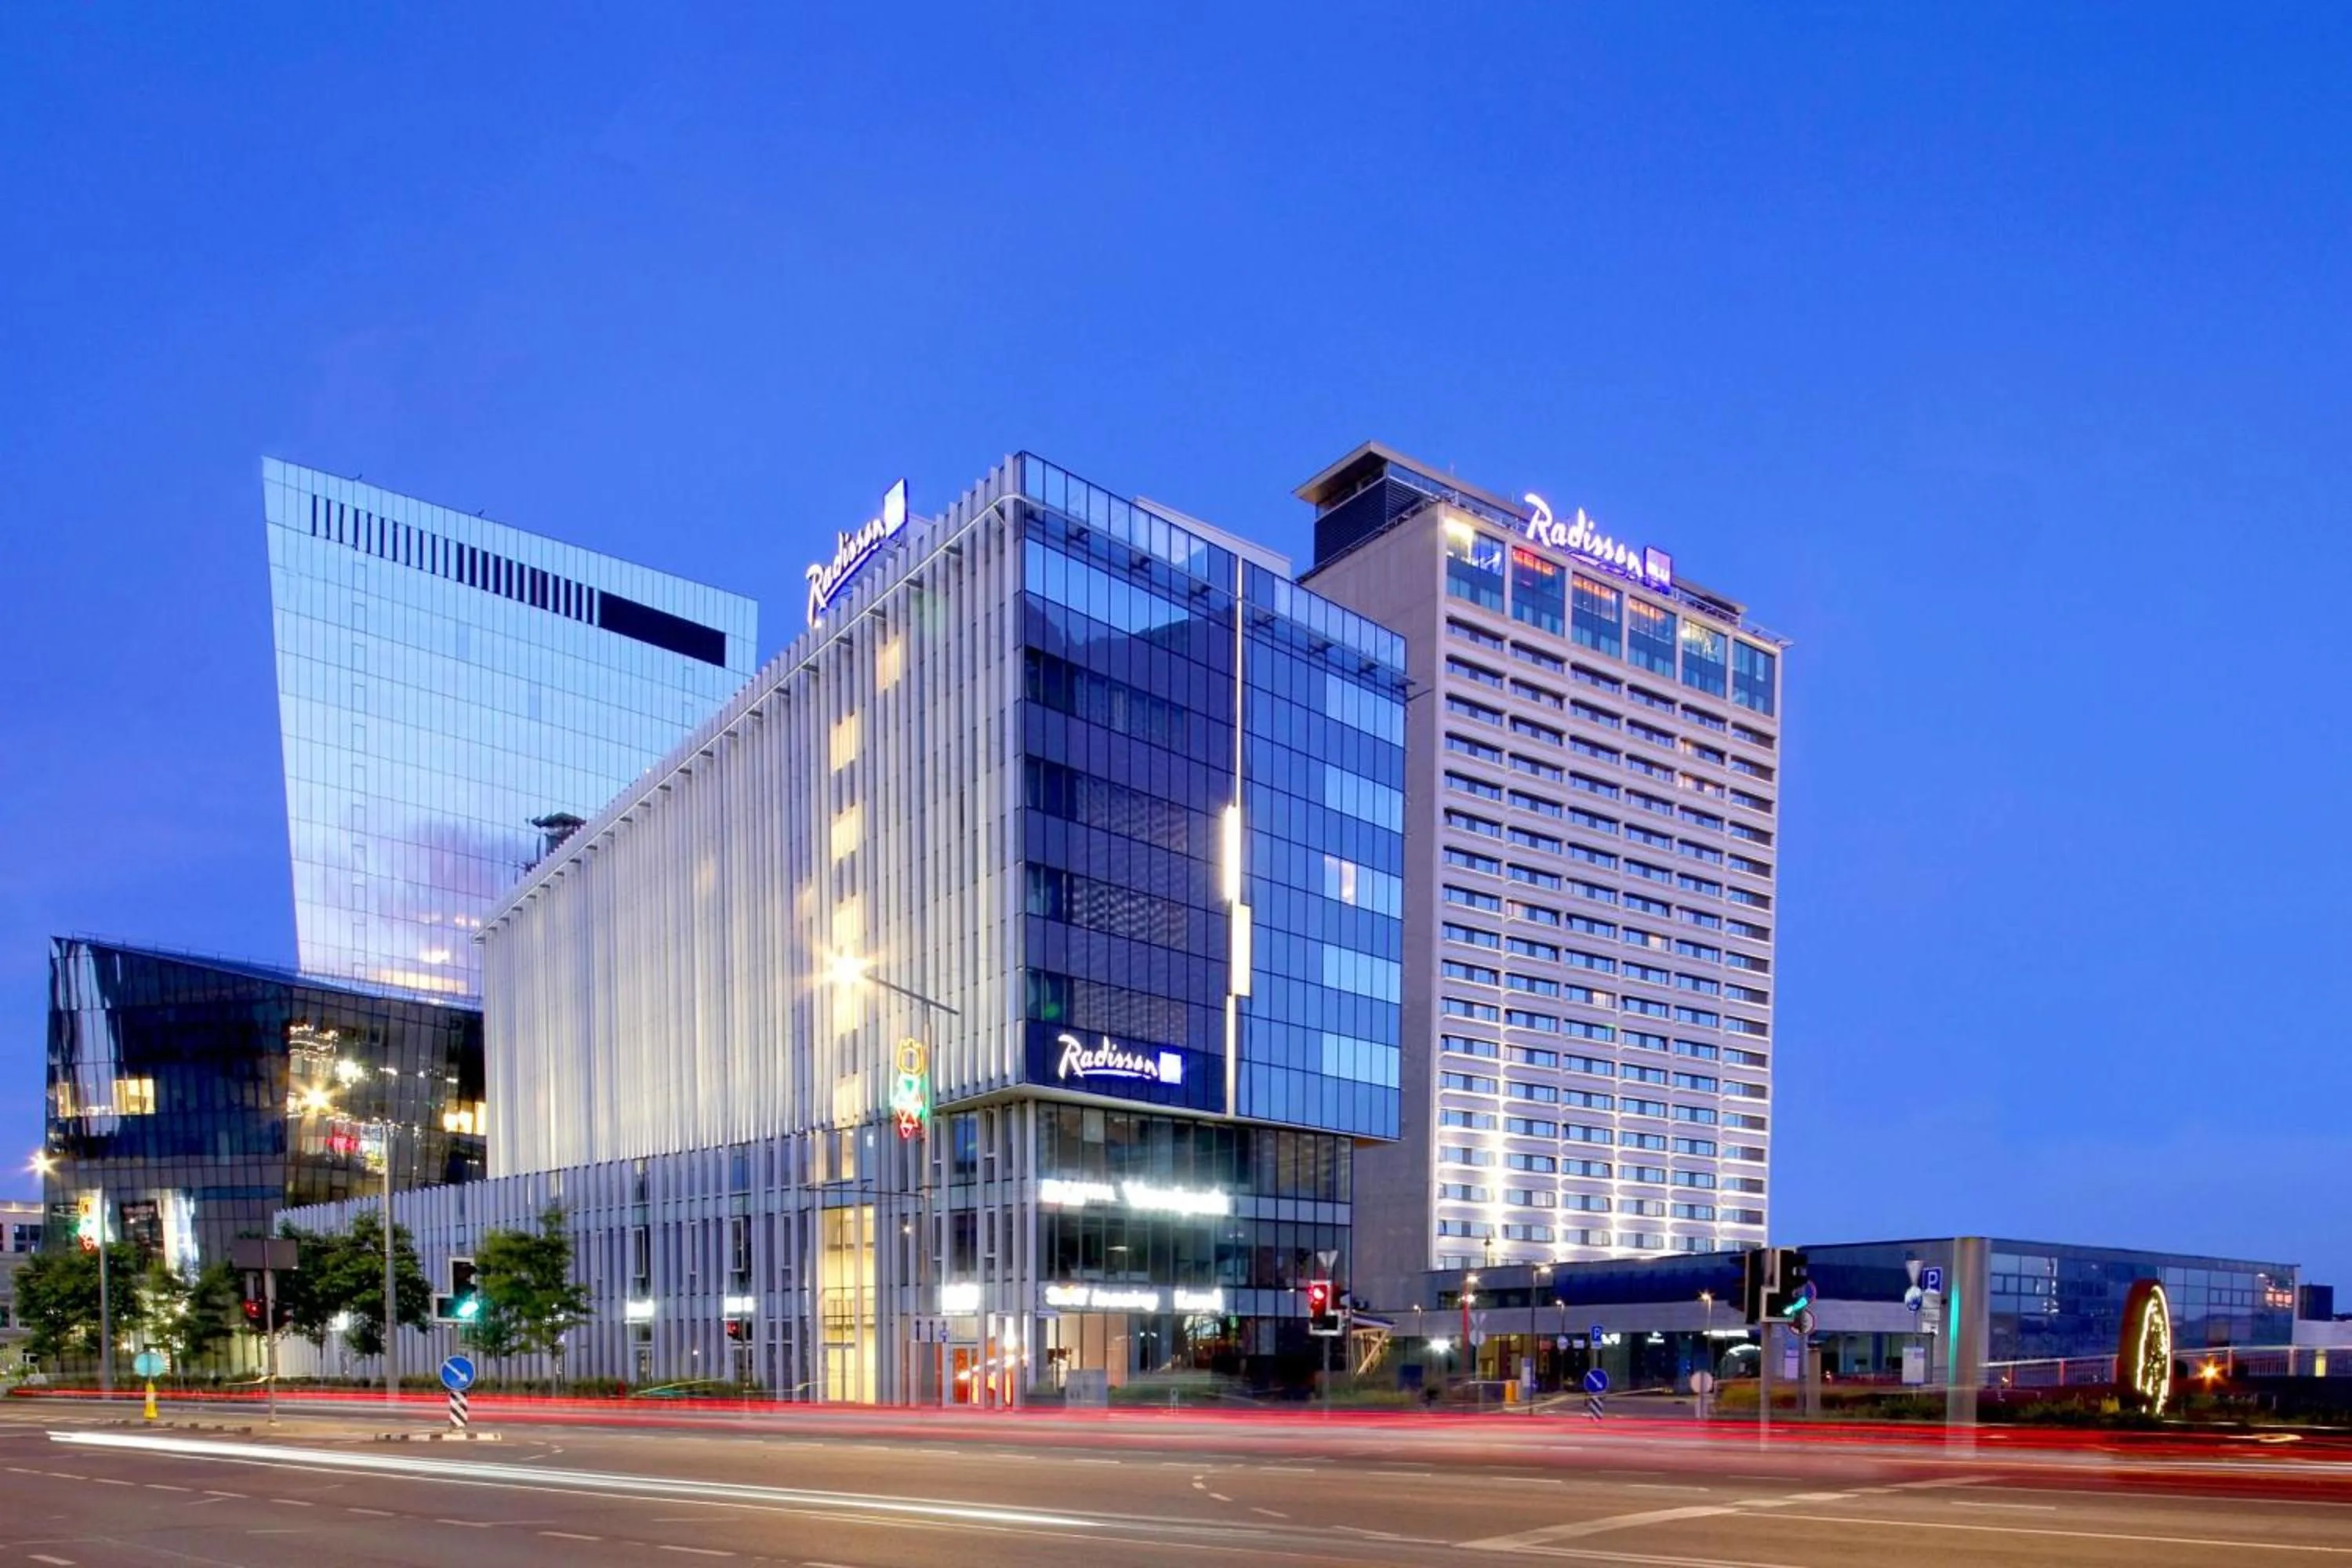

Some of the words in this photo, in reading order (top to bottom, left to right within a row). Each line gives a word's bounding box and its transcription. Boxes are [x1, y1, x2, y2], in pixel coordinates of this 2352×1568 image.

[1523, 492, 1643, 578] Radisson
[806, 517, 886, 629] Radisson
[1058, 1033, 1158, 1080] Radisson
[1927, 1271, 1939, 1290] P
[1593, 1327, 1601, 1339] P
